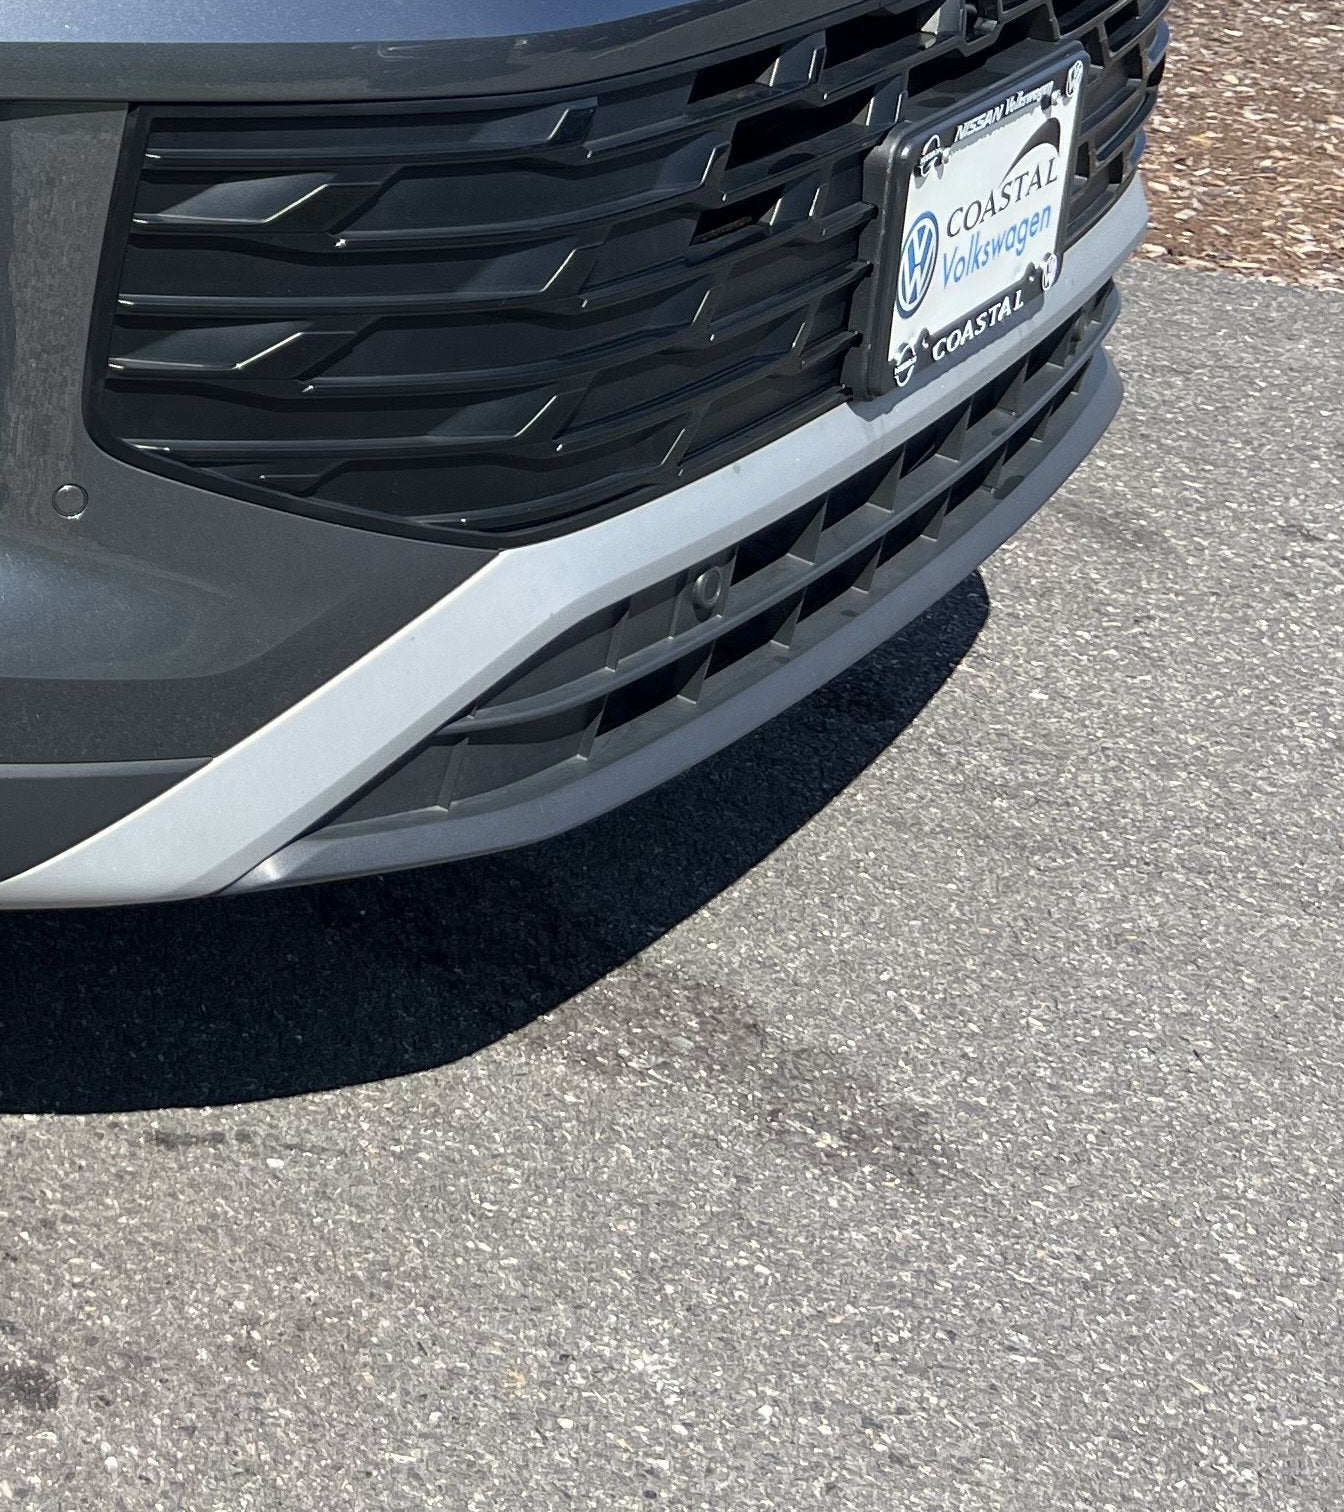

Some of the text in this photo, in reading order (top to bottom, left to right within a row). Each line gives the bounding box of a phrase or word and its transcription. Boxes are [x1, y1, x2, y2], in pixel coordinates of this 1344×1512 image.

[954, 103, 1004, 143] NISSAN
[947, 158, 1058, 237] COASTAL
[897, 212, 939, 316] VW
[943, 205, 1052, 290] Volkswagen
[932, 288, 1025, 362] COASTAL
